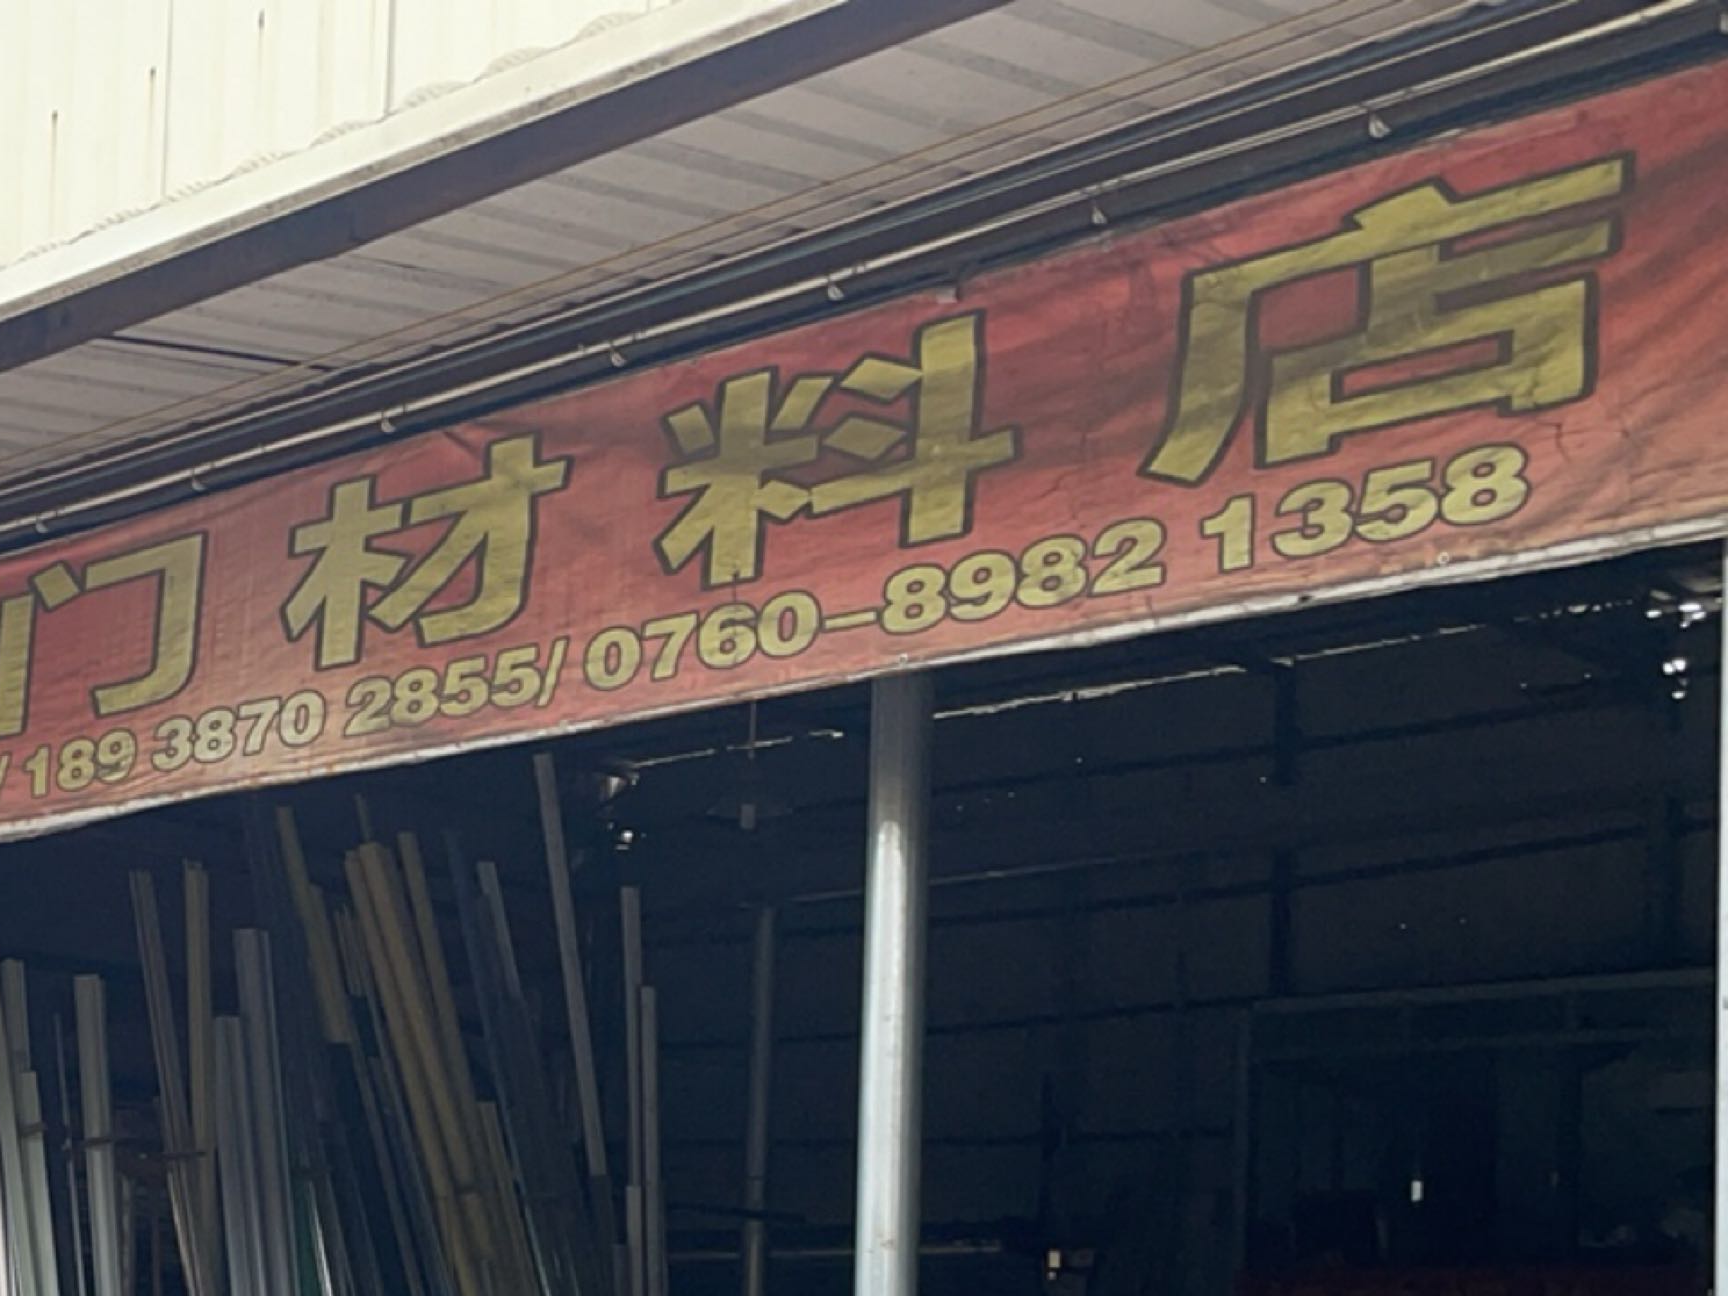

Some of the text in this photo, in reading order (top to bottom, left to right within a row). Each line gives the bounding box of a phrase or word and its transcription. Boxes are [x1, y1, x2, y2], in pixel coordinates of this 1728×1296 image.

[23, 729, 133, 797] 189
[152, 691, 325, 768] 3870
[583, 516, 1167, 690] 0760-8982
[1200, 446, 1530, 571] 1358
